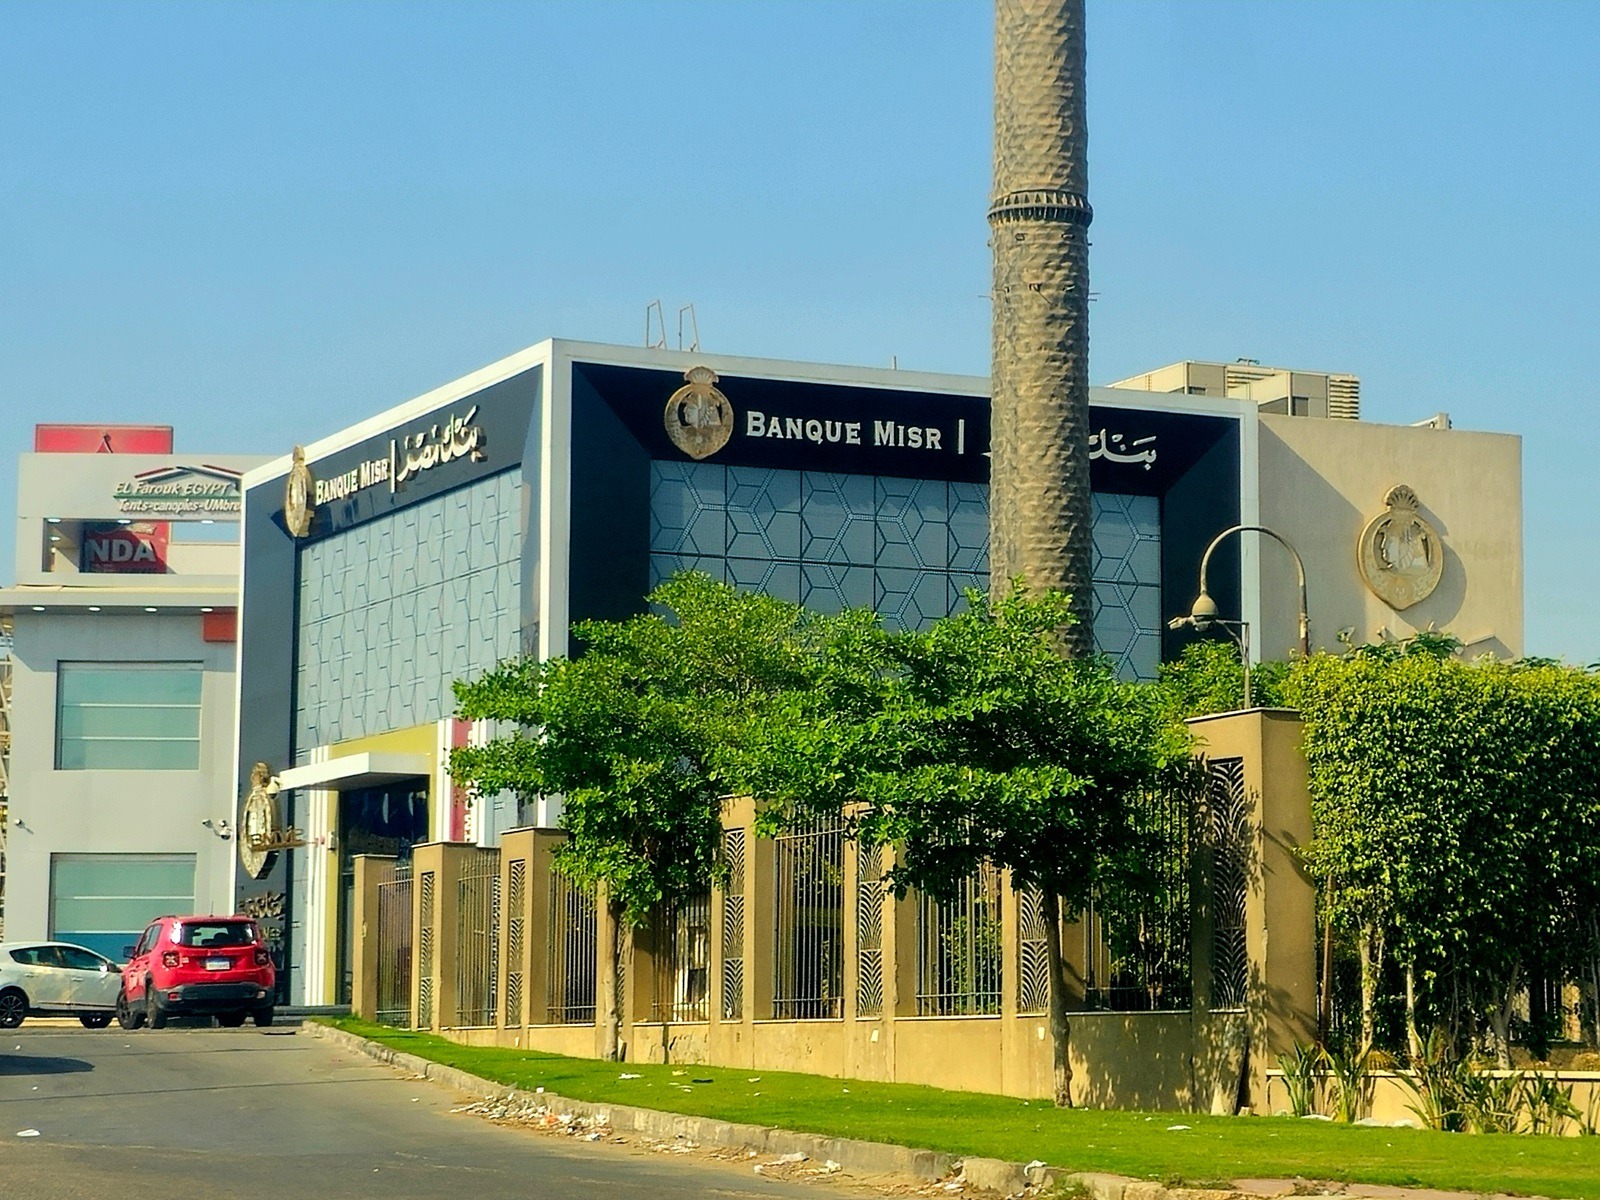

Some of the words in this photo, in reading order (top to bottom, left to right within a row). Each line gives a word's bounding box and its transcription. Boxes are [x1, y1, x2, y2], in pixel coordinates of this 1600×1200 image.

[746, 410, 861, 446] BANQUE
[874, 420, 942, 450] MISR
[134, 481, 181, 495] Farouk
[184, 482, 230, 496] EGYPT
[315, 468, 359, 507] BANQUE
[360, 457, 389, 489] MISR
